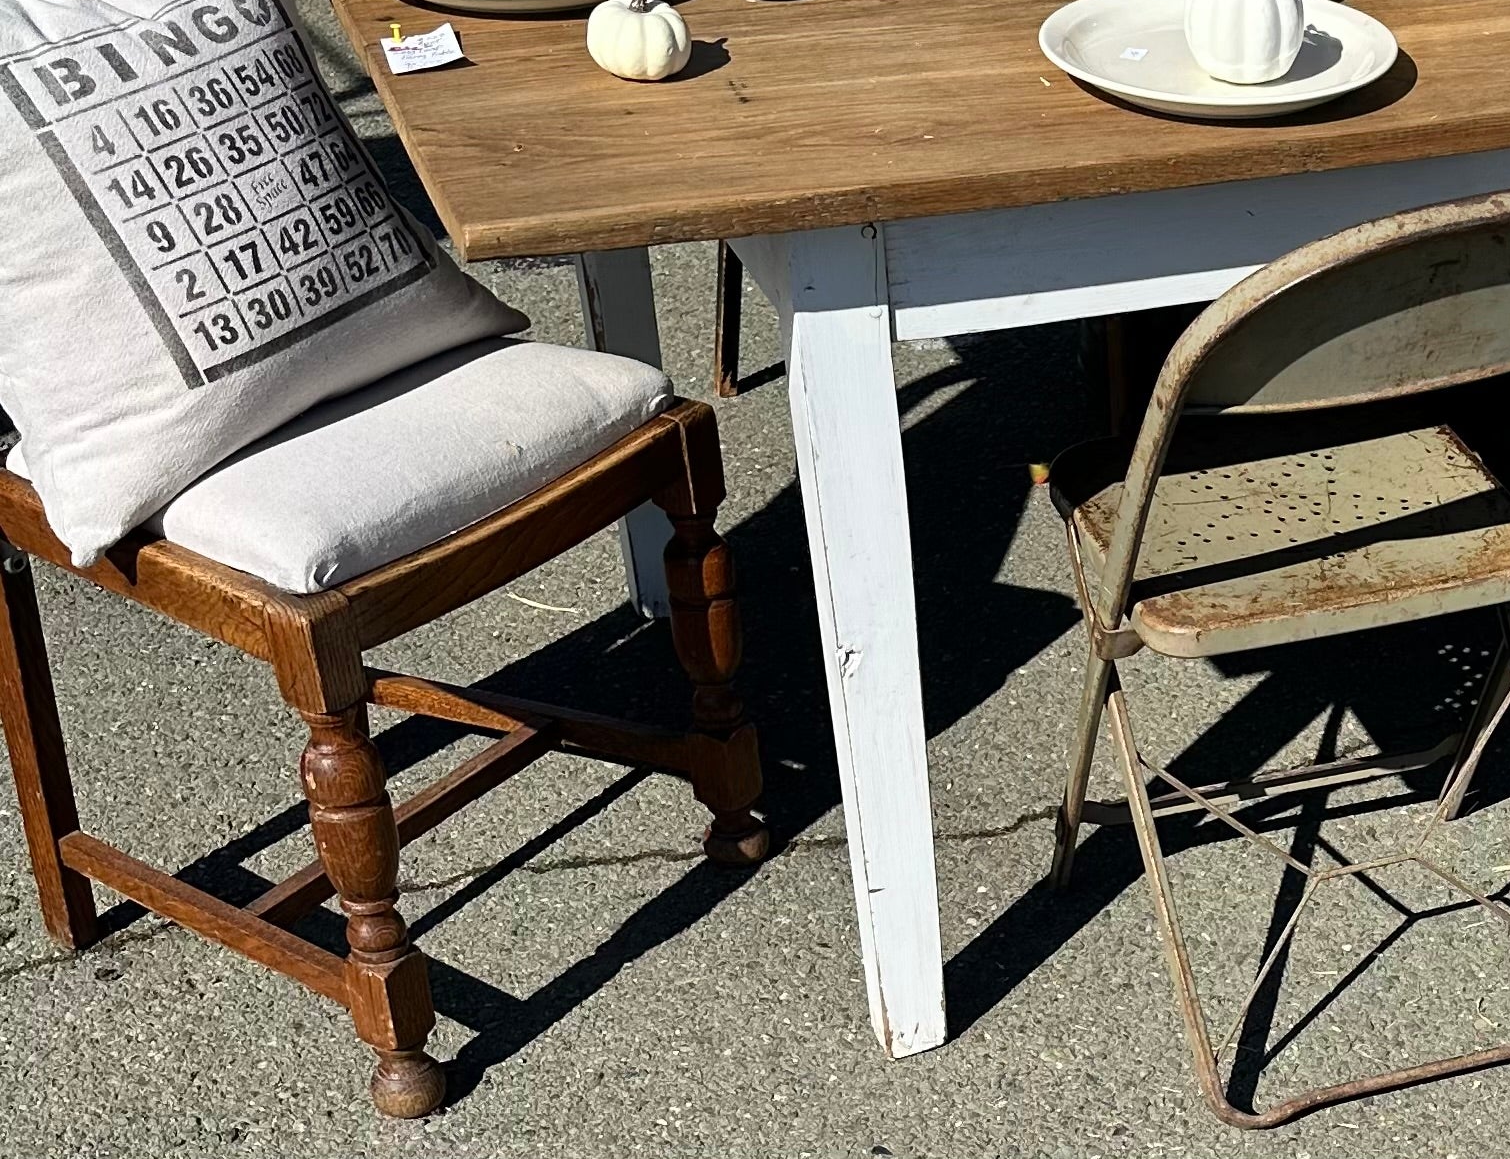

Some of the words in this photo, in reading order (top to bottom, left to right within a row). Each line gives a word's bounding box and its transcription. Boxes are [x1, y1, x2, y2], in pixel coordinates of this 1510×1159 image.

[91, 125, 116, 156] 4
[134, 99, 181, 137] 16
[188, 78, 234, 116] 36
[234, 58, 276, 96] 54
[273, 44, 304, 79] 68
[107, 170, 156, 209] 14
[163, 146, 214, 189] 26
[218, 124, 263, 165] 35
[264, 106, 305, 143] 50
[301, 92, 333, 127] 72
[146, 221, 176, 253] 9
[193, 193, 243, 236] 28
[299, 151, 330, 187] 47
[330, 137, 359, 172] 64
[175, 268, 206, 302] 2
[223, 242, 265, 280] 17
[279, 219, 320, 256] 42
[321, 197, 356, 235] 59
[355, 182, 386, 218] 66
[194, 313, 239, 351] 13
[247, 288, 292, 330] 30
[300, 266, 338, 306] 39
[343, 245, 380, 283] 52
[378, 226, 412, 263] 70
